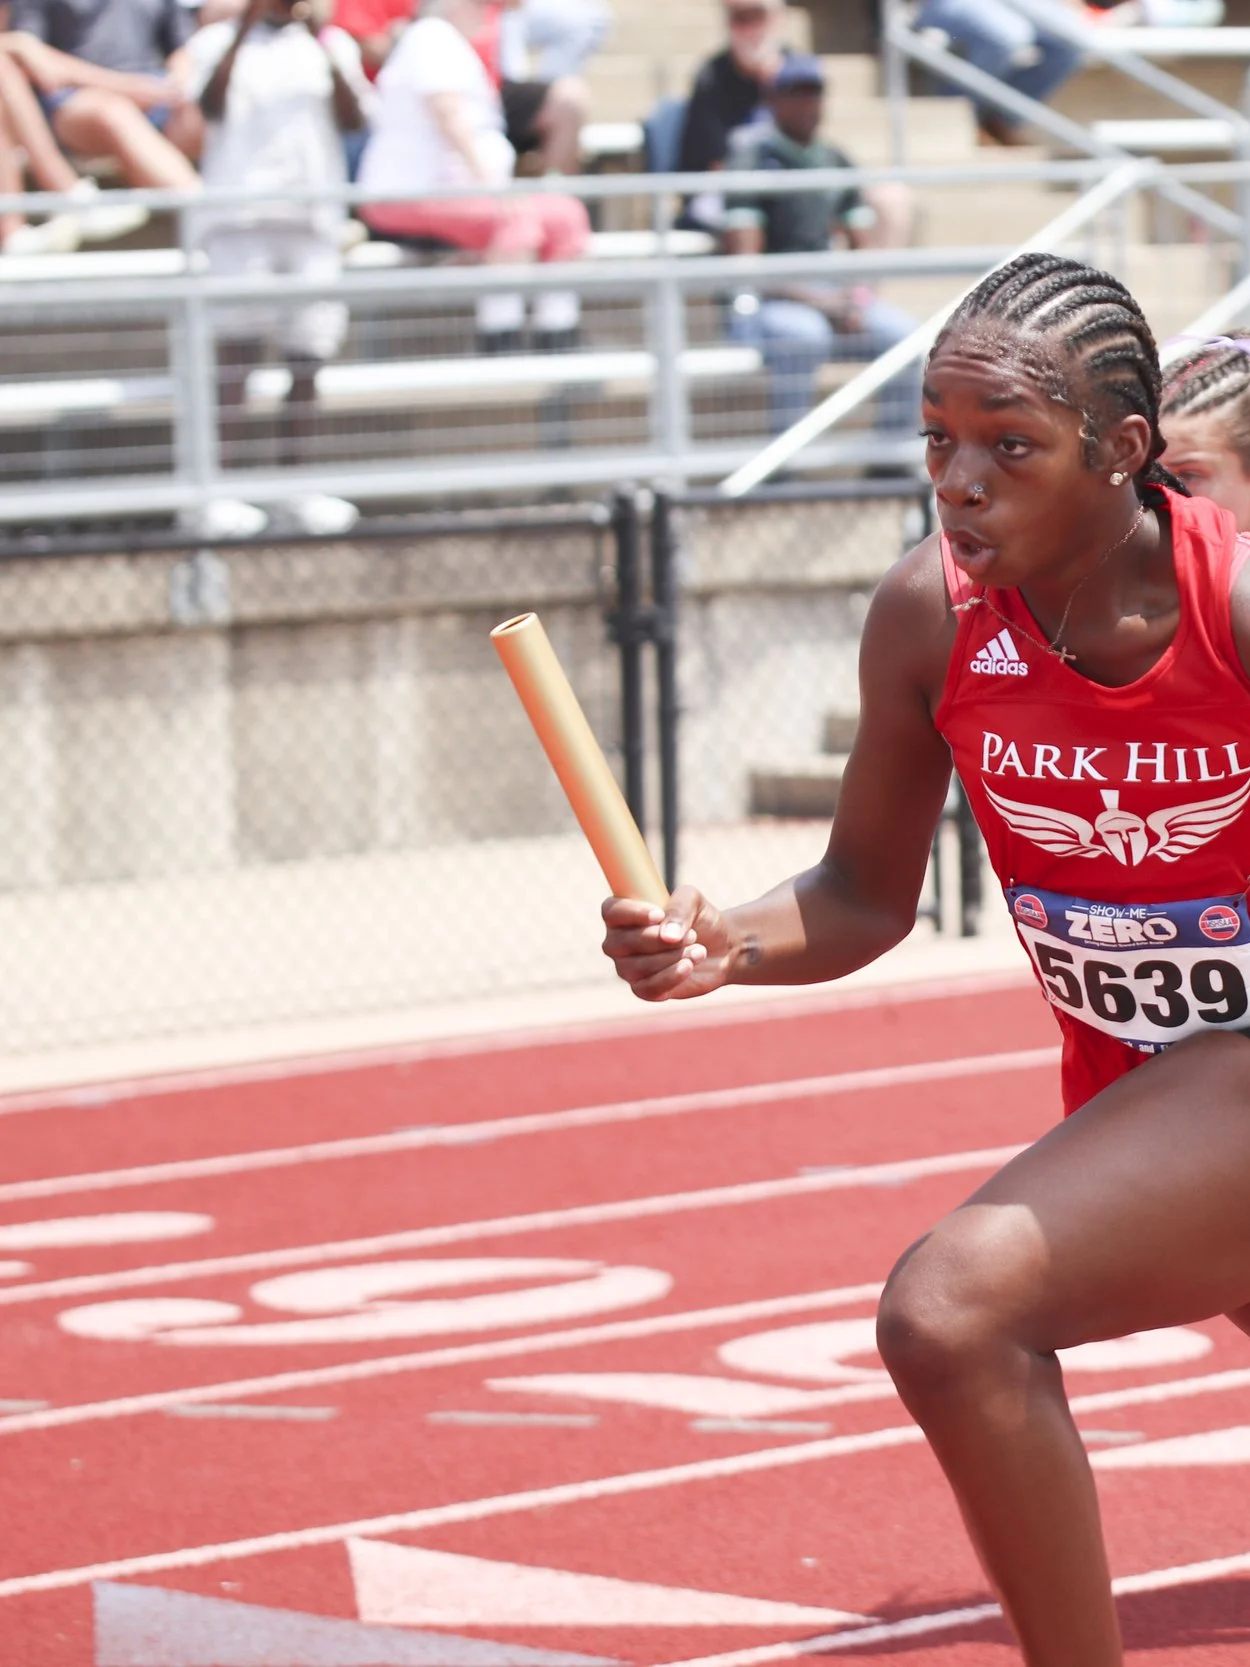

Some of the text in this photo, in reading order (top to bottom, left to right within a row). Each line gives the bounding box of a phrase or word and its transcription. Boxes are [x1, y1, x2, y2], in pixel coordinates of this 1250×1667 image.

[969, 656, 1029, 677] adidas
[980, 730, 1108, 782] PARK
[1064, 909, 1178, 944] ZERO
[1088, 904, 1148, 919] SHOW-ME
[1034, 941, 1249, 1029] 5639
